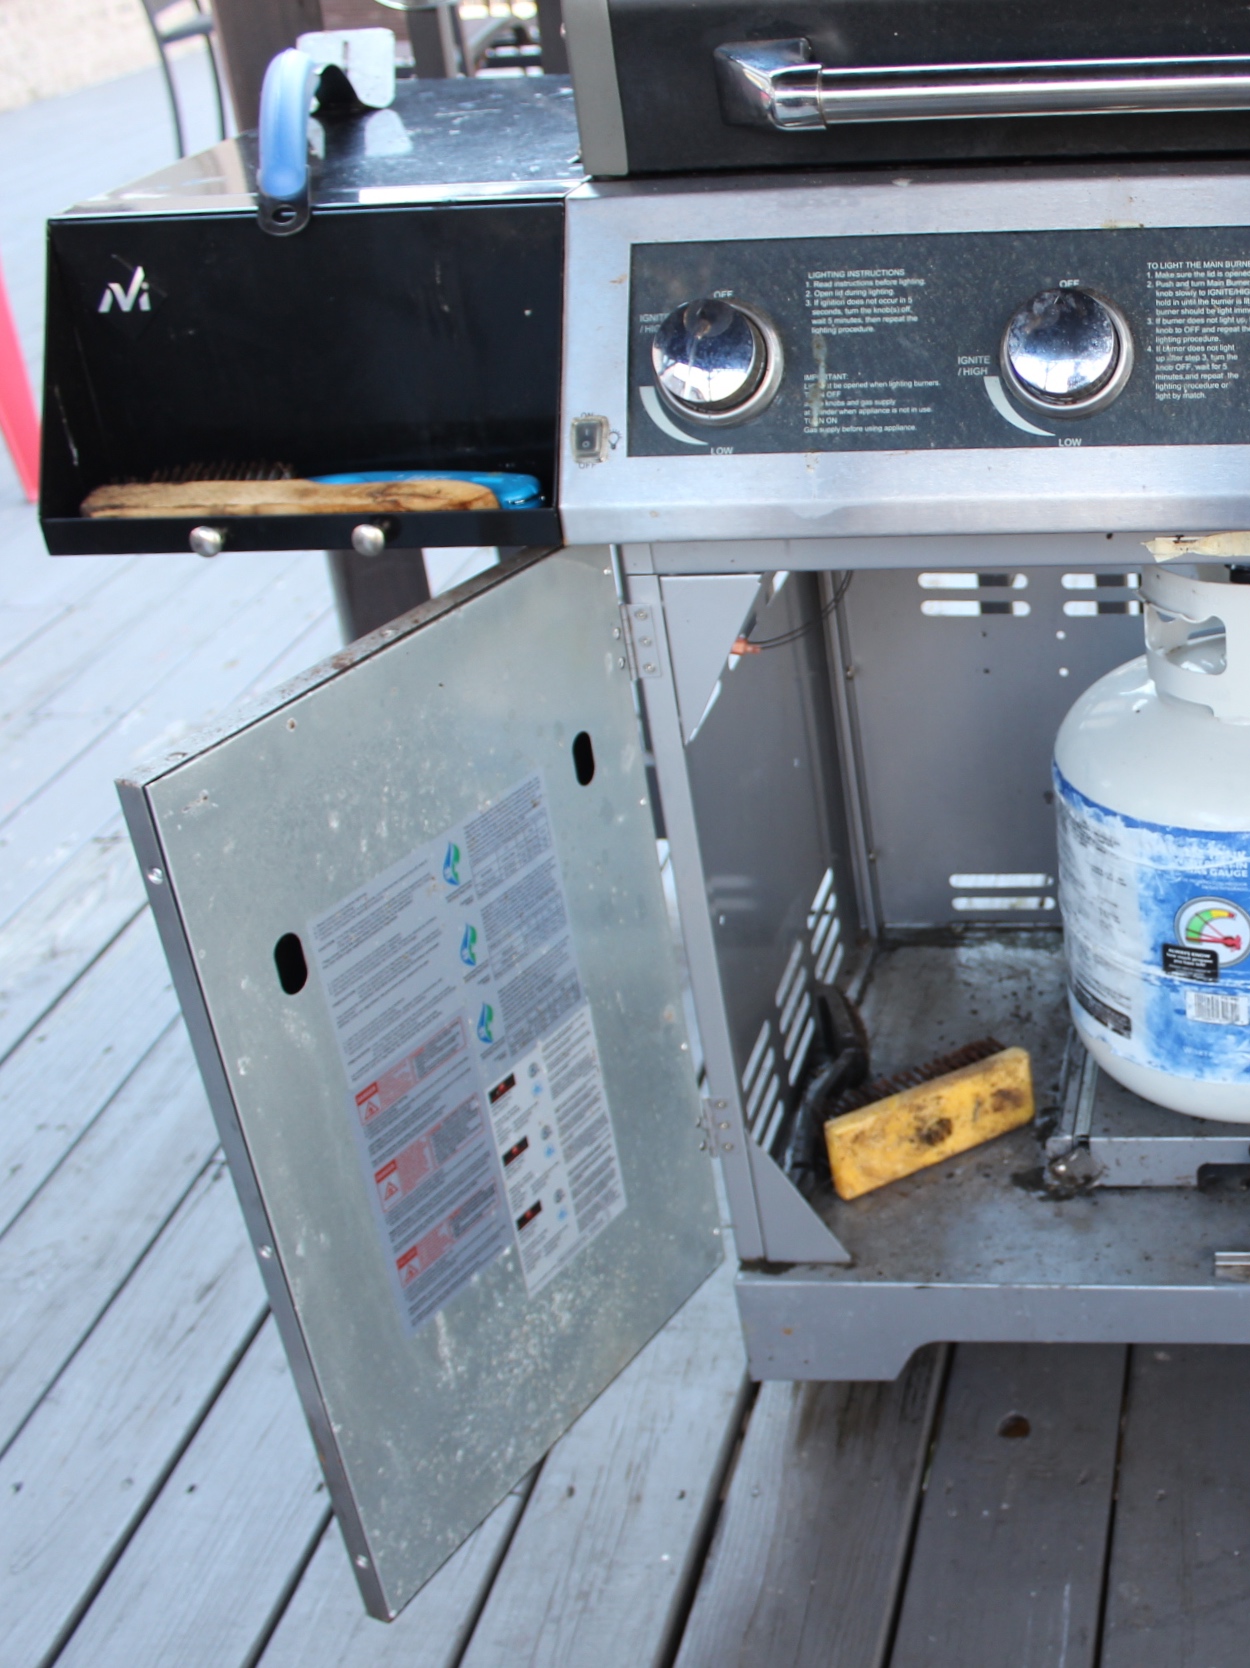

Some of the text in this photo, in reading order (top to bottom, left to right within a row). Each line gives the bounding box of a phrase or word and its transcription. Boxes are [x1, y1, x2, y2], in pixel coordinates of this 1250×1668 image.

[808, 269, 905, 279] LIGHTING INSTRUCTIONS
[899, 278, 926, 286] lighting.
[1059, 279, 1080, 288] OFF
[713, 290, 733, 298] OFF
[814, 290, 833, 298] Open
[845, 289, 867, 297] during
[869, 288, 894, 296] lighting.
[1175, 289, 1197, 298] slowly
[821, 299, 844, 307] ignition
[958, 356, 990, 364] IGNITE
[889, 381, 912, 389] lighting
[819, 426, 840, 434] supply
[842, 425, 862, 433] before
[865, 425, 882, 433] using
[884, 424, 916, 432] appliance.
[1058, 438, 1082, 447] LOW
[711, 447, 733, 455] LOW
[1210, 868, 1248, 878] GAUGE
